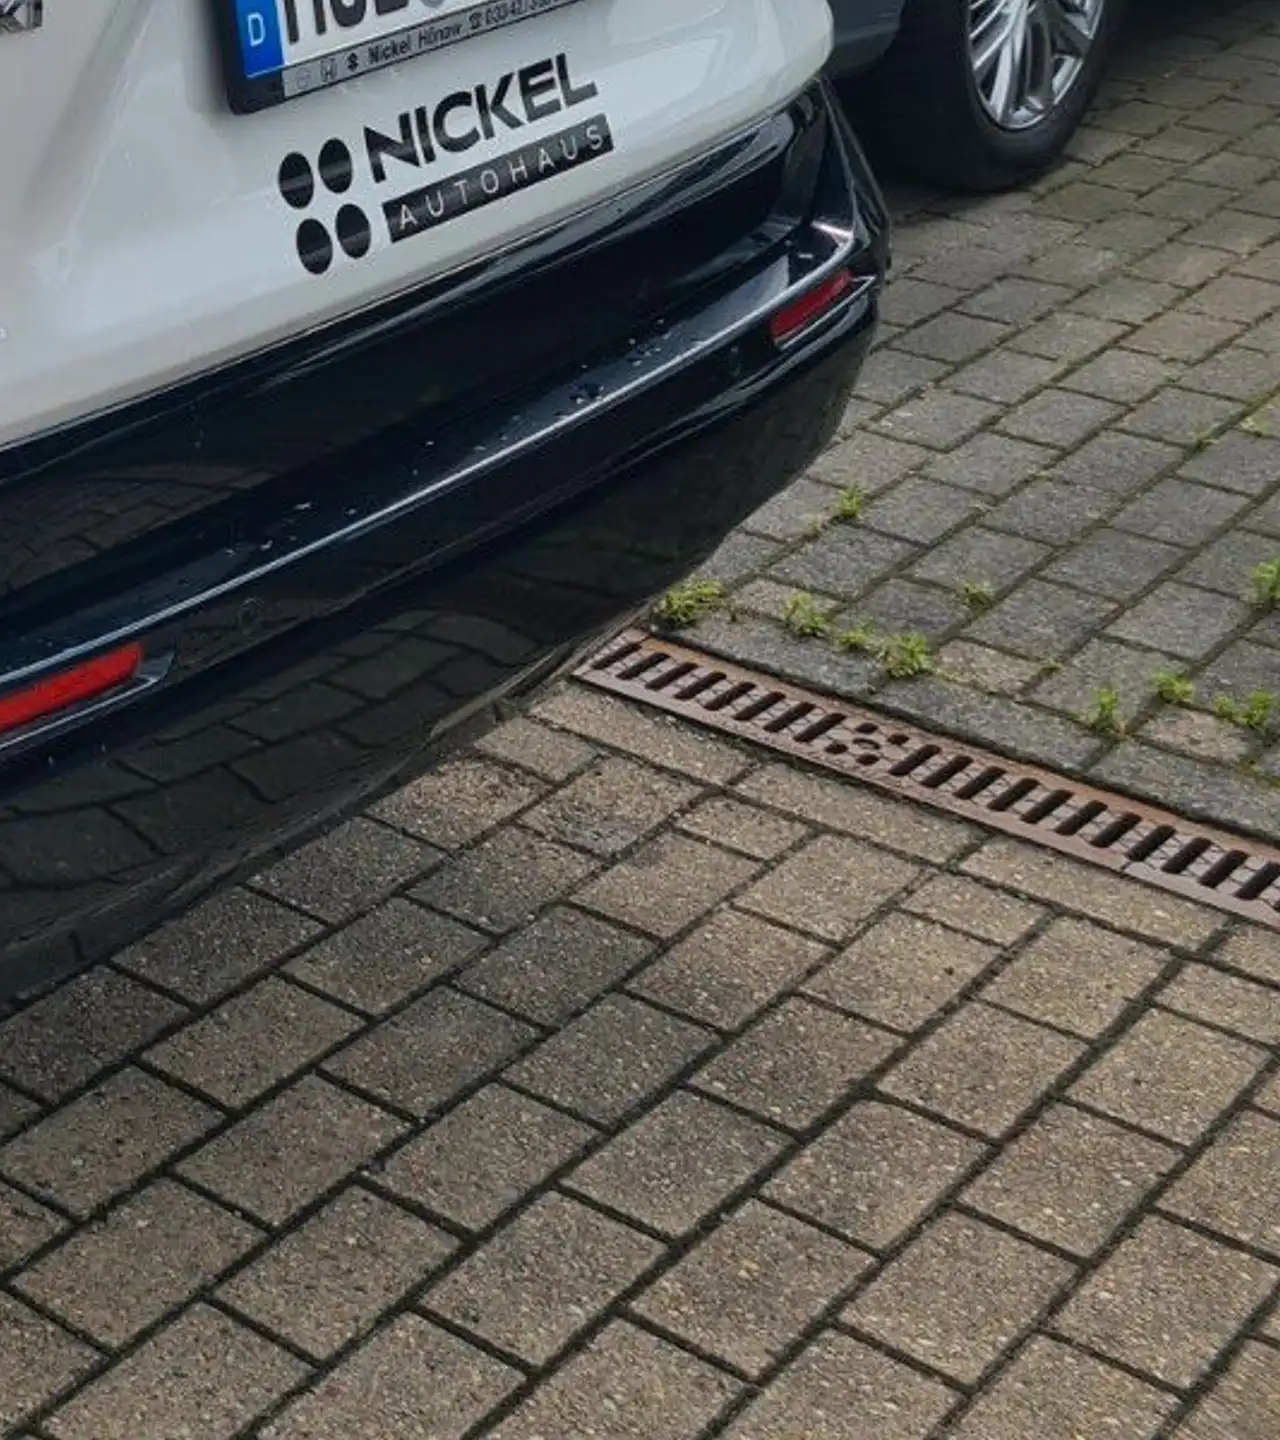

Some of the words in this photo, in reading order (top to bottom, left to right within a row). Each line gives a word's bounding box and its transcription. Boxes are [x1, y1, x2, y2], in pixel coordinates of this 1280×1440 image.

[247, 11, 266, 47] D
[362, 53, 598, 183] NICKEL
[399, 124, 604, 231] AUTOHAUS
